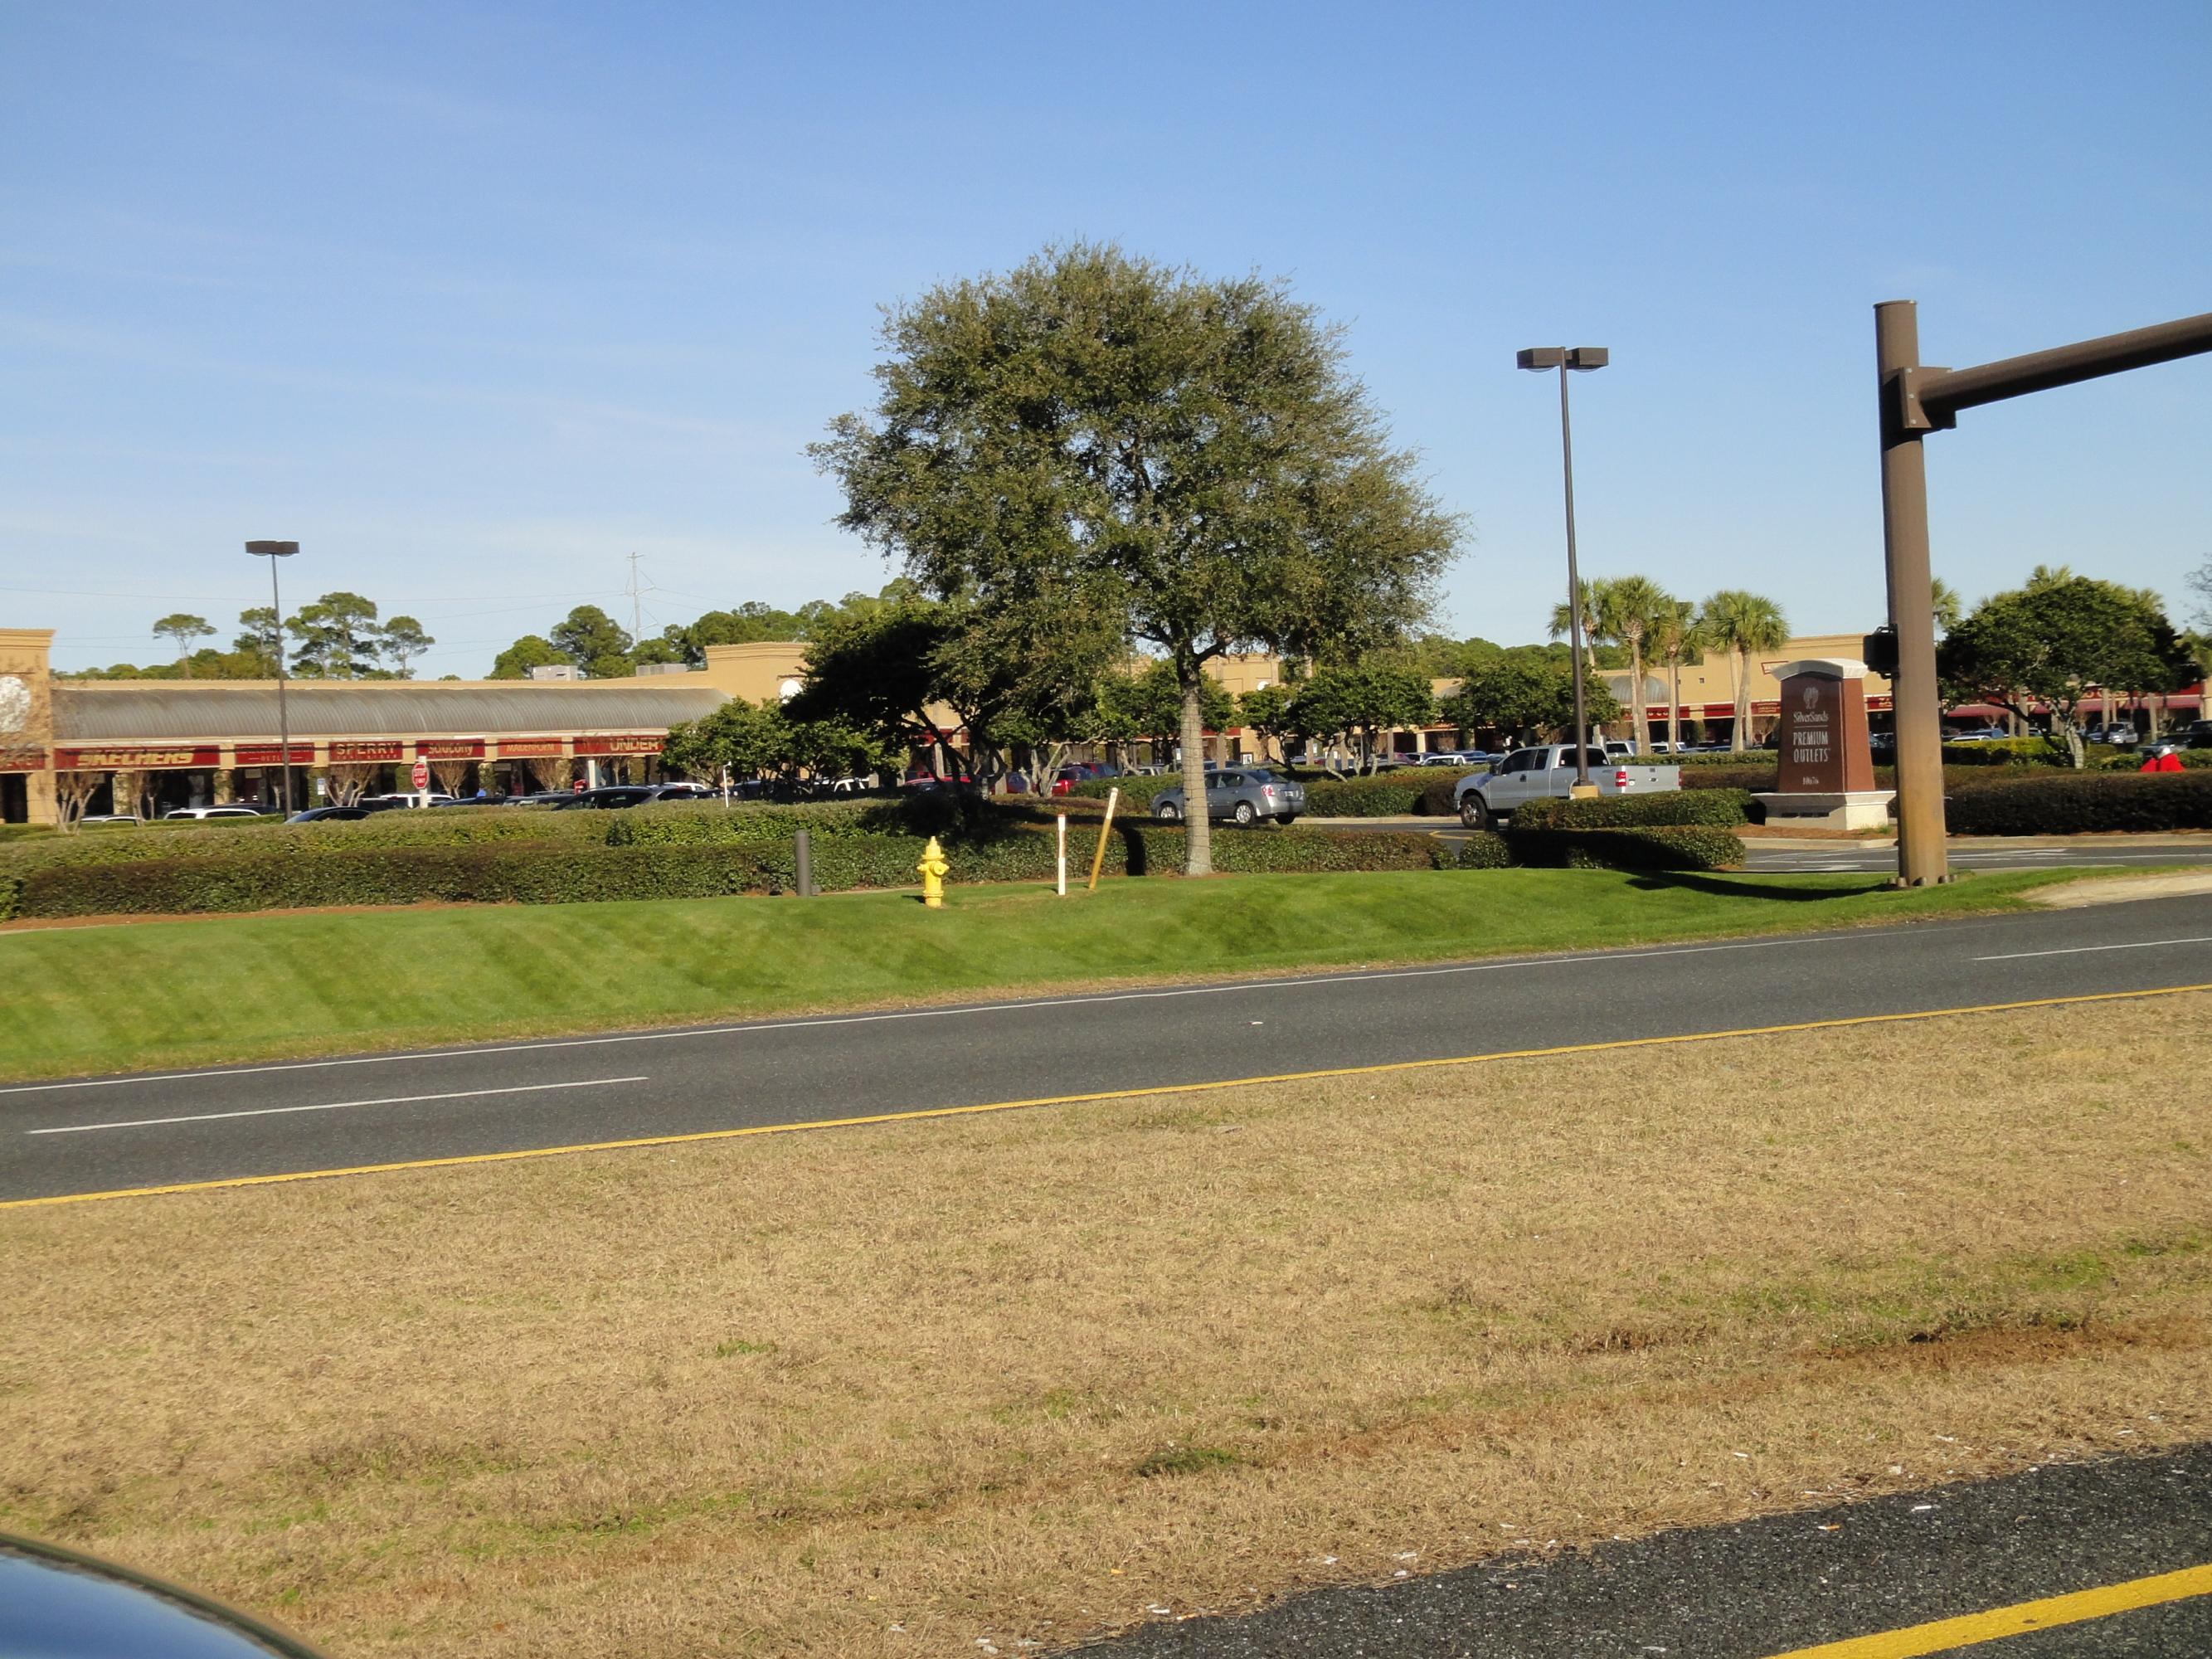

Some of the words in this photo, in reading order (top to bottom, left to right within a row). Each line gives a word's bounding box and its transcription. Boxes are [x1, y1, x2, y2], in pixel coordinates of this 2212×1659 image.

[610, 737, 659, 752] UNDER
[1793, 731, 1829, 746] PREMIUM
[336, 742, 397, 756] SPERRY
[1793, 748, 1829, 763] OUTLETS
